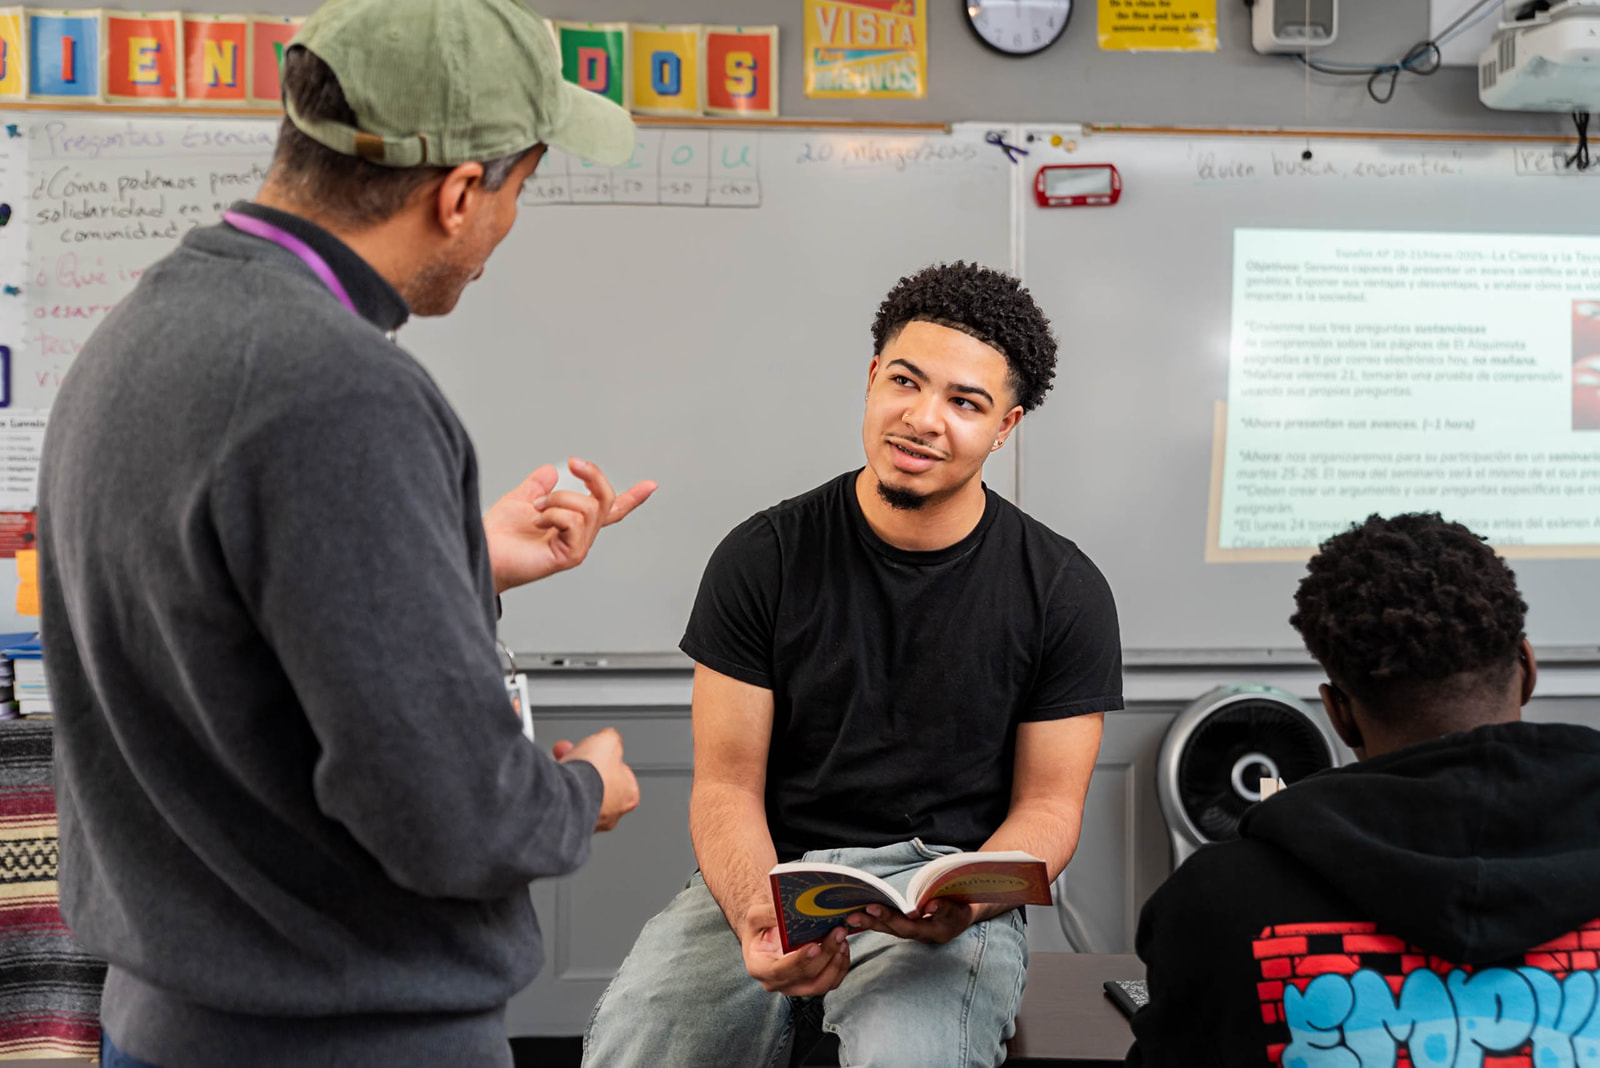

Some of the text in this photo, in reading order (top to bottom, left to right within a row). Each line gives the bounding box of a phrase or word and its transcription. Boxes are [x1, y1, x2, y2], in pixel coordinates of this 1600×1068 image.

[815, 5, 917, 46] VISTA
[45, 121, 165, 157] Preguntas
[117, 169, 196, 200] podemos
[37, 195, 165, 225] solidaridad
